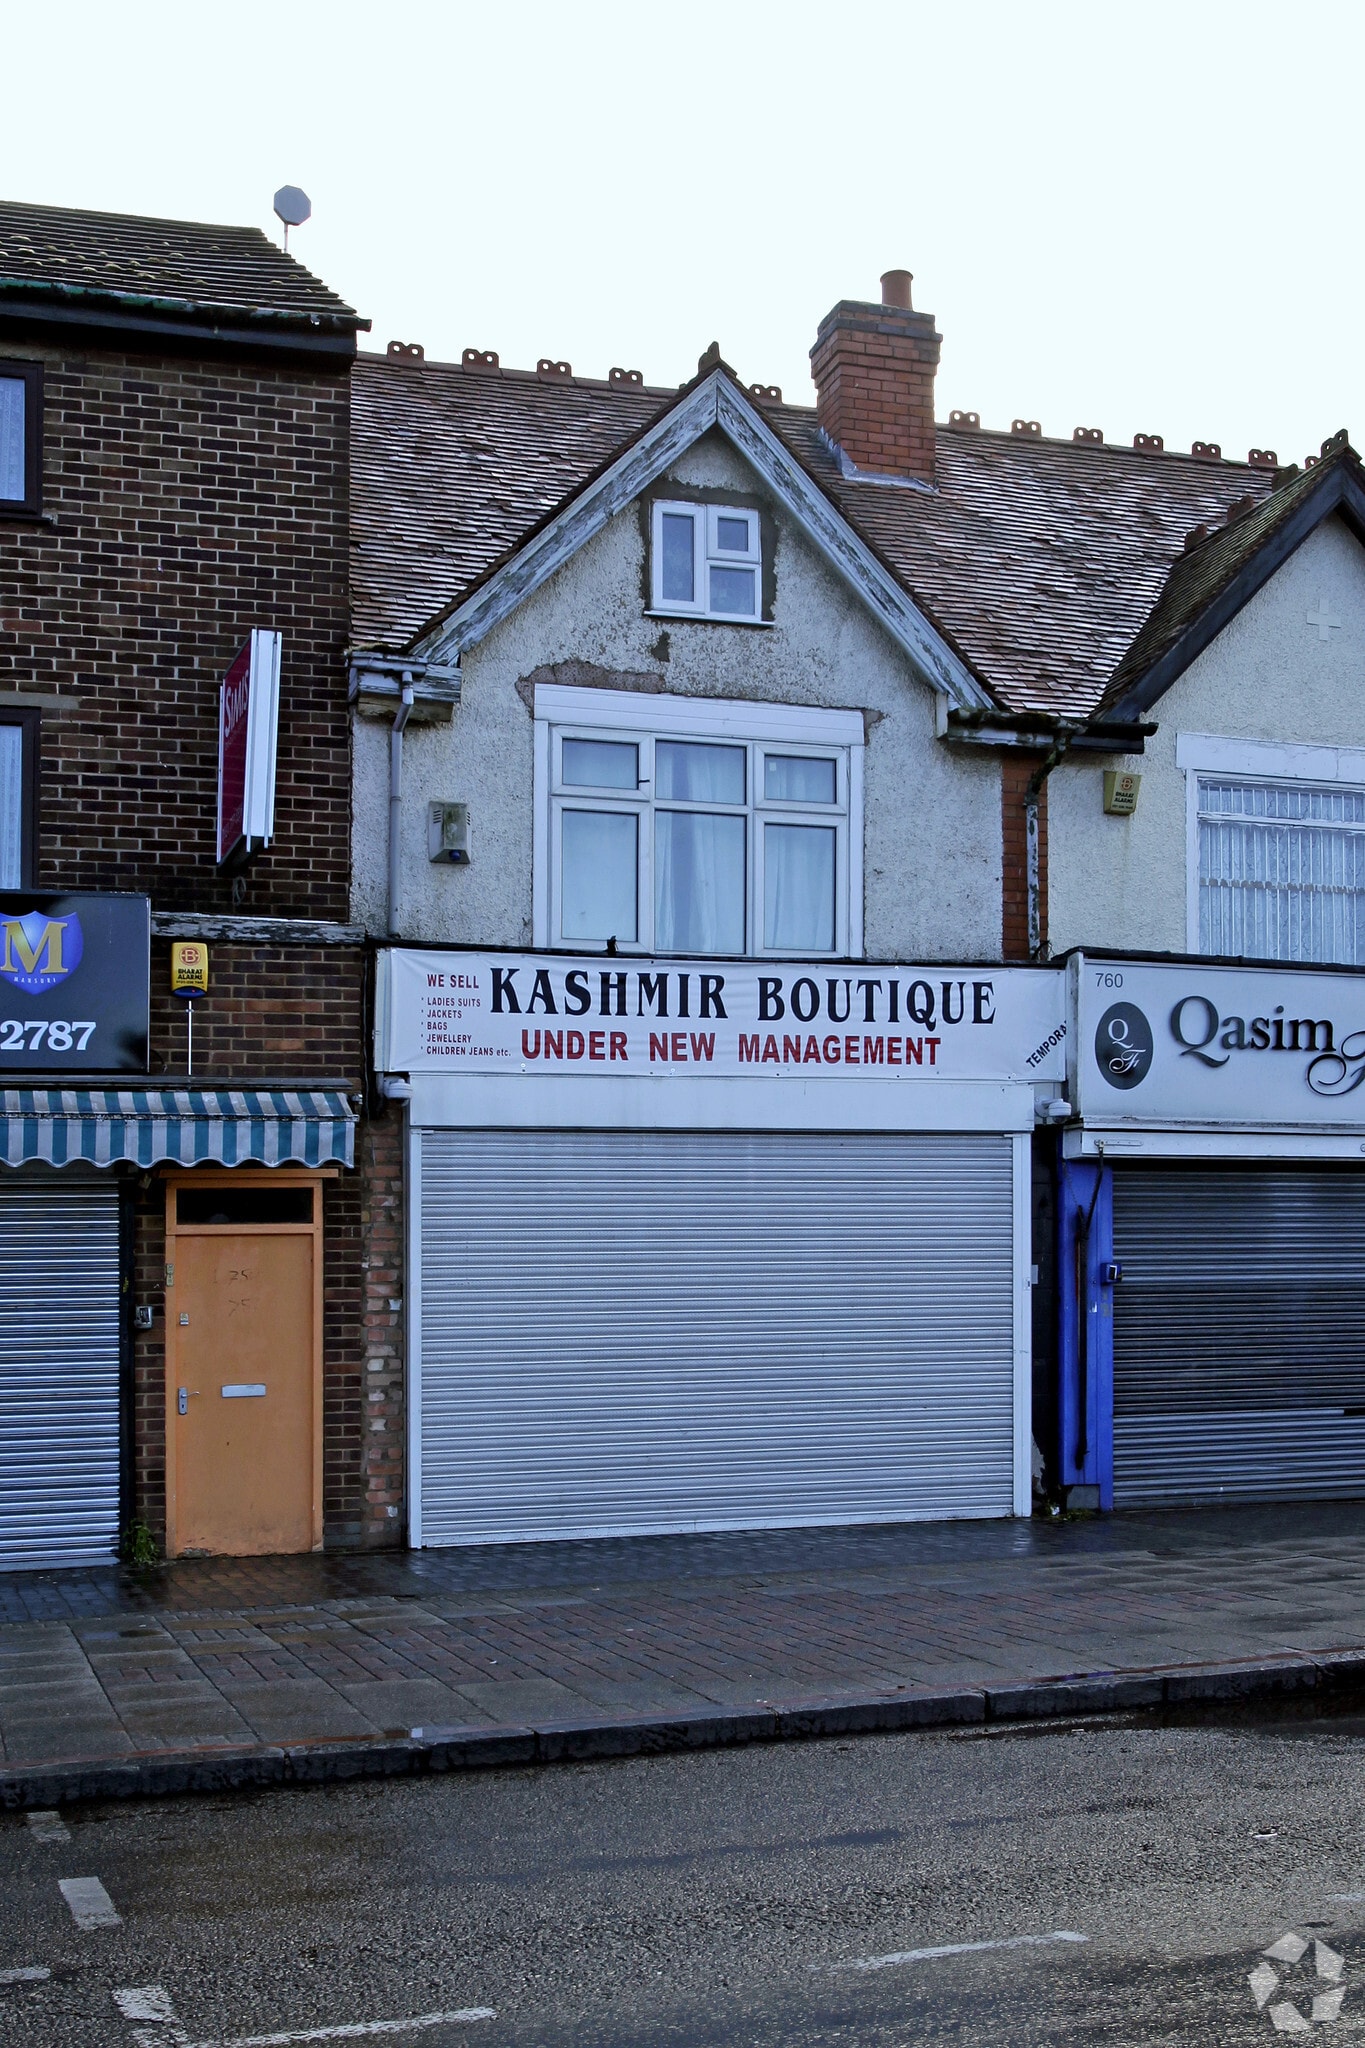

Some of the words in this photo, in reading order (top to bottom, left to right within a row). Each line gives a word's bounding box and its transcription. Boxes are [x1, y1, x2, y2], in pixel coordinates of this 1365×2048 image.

[0, 920, 69, 974] M
[427, 973, 445, 988] WE
[450, 974, 480, 989] SELL
[1095, 972, 1124, 988] 760
[427, 997, 455, 1007] LADIES
[457, 998, 481, 1008] SUITS
[489, 967, 729, 1019] KASHMIR
[756, 976, 997, 1032] BOUTIQUE
[427, 1009, 462, 1019] JACKETS
[0, 1020, 97, 1051] 2787
[427, 1021, 448, 1031] BAGS
[1107, 1018, 1134, 1049] Q
[1169, 995, 1337, 1069] Qasim
[426, 1033, 473, 1043] JEWELLERY
[521, 1029, 629, 1061] UNDER
[649, 1032, 716, 1062] NEW
[738, 1033, 942, 1066] MANAGEMENT
[1025, 1019, 1067, 1068] TEMPORA
[426, 1045, 466, 1056] CHILDREN
[468, 1046, 494, 1056] JEANS
[496, 1048, 512, 1057] etc.
